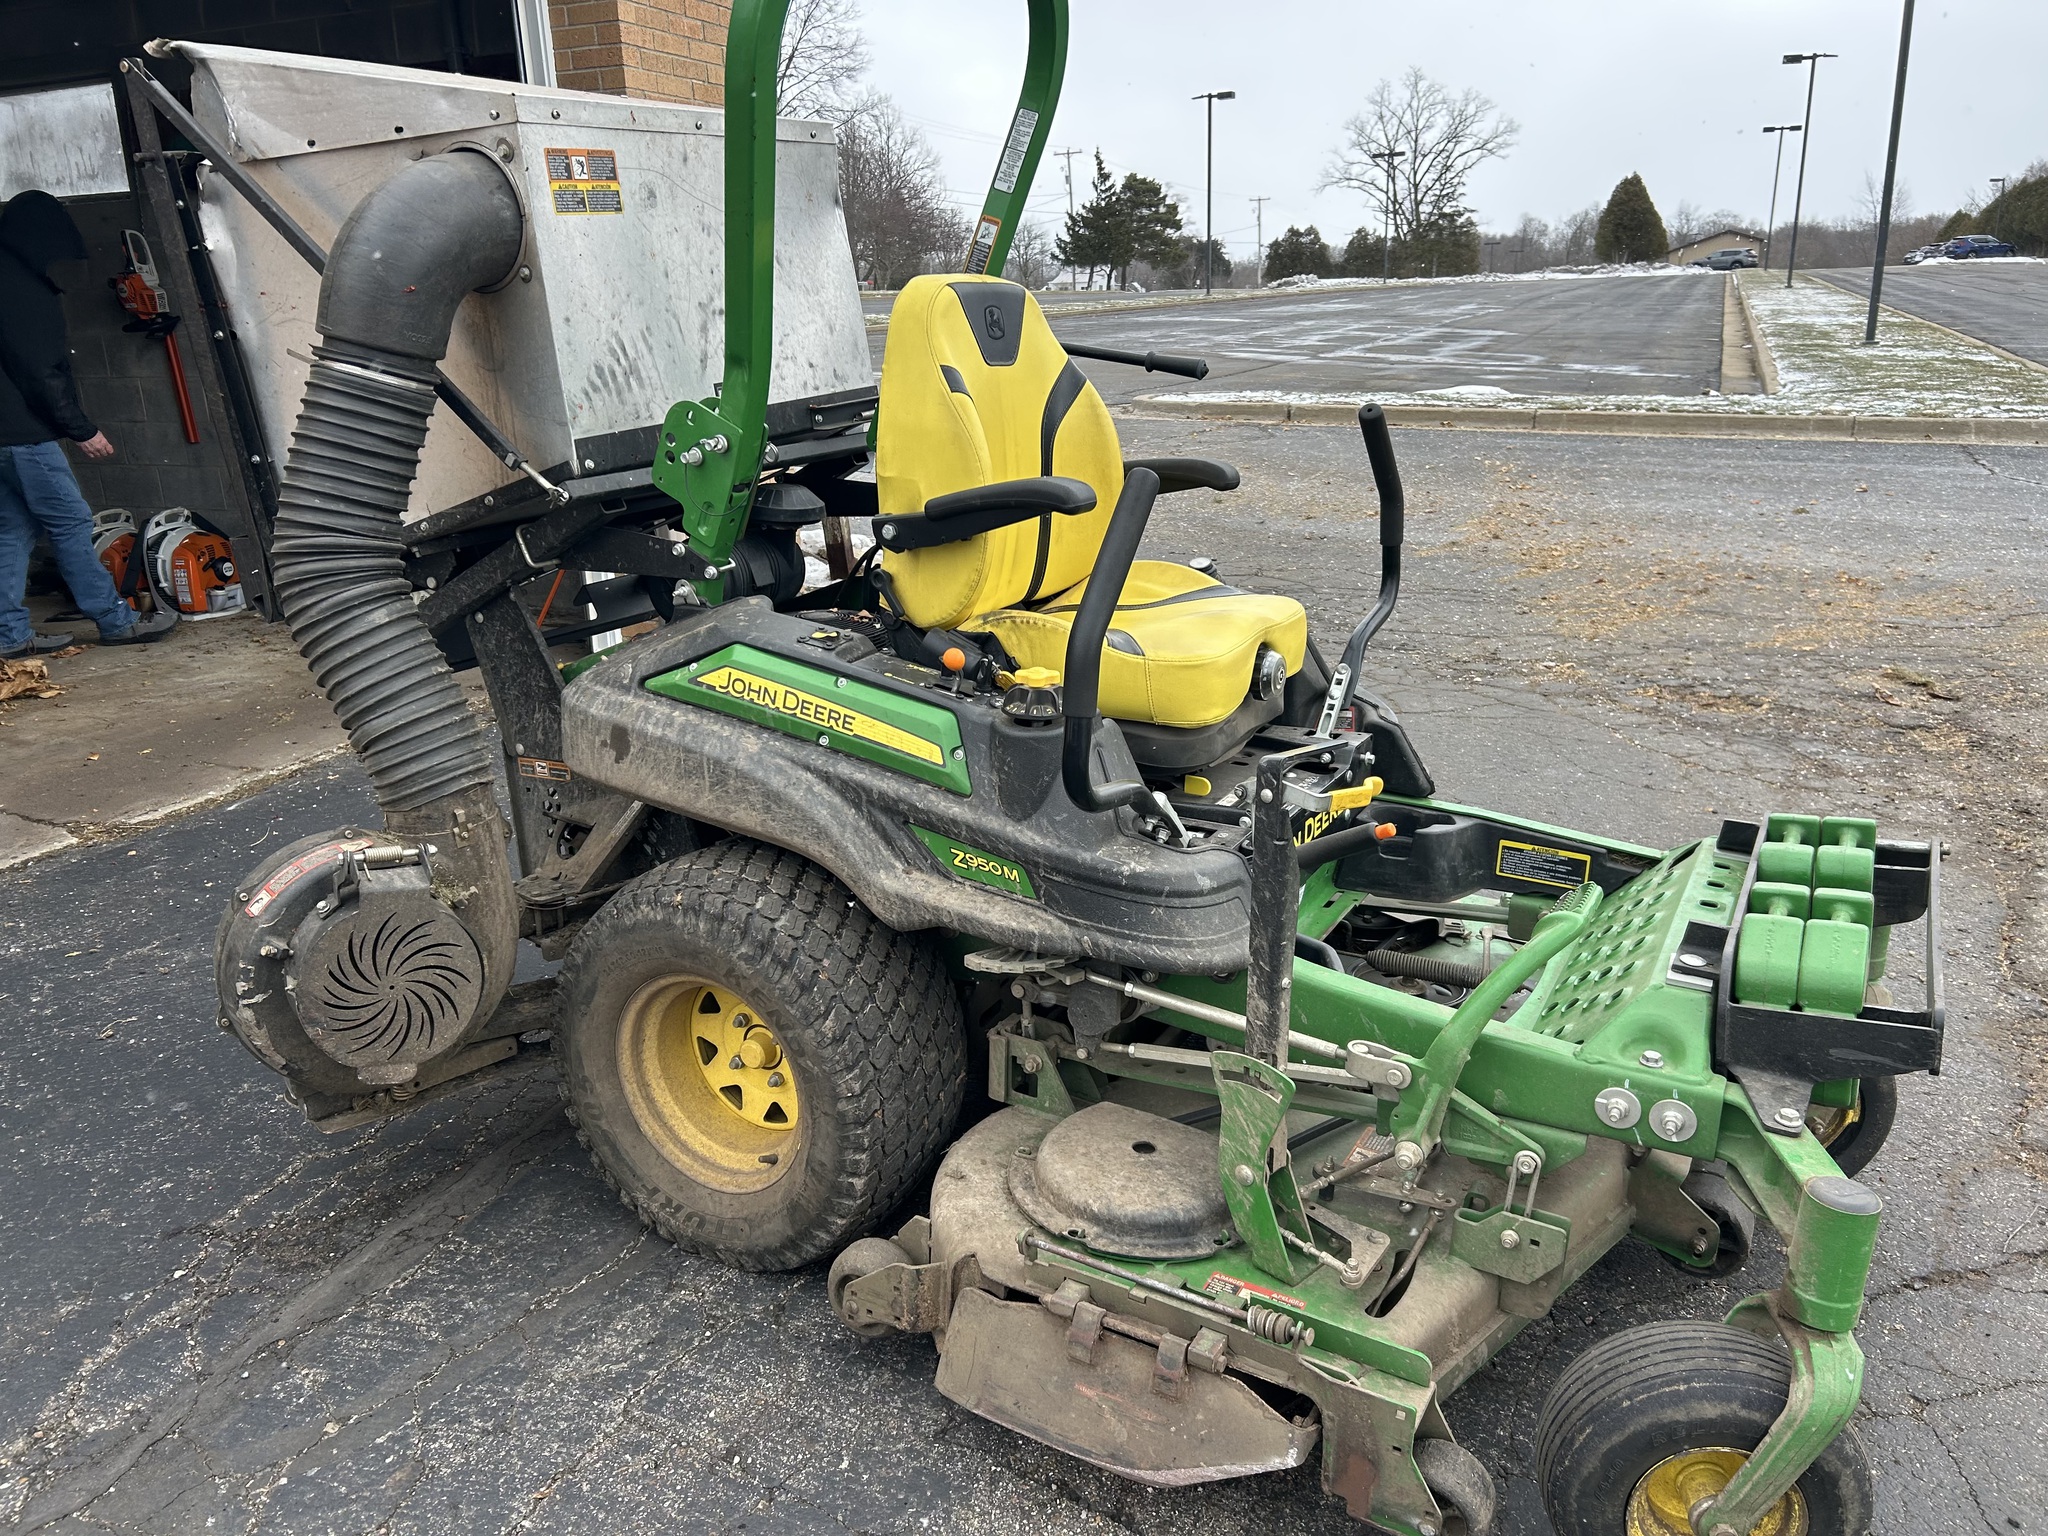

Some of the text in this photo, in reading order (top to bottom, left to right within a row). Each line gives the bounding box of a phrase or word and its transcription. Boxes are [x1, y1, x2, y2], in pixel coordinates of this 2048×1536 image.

[717, 671, 857, 734] JOHN DEERE
[1304, 809, 1344, 844] DEER
[639, 1183, 729, 1241] TURF
[1219, 1274, 1245, 1288] DANGER
[1278, 1293, 1305, 1307] PELIGRO
